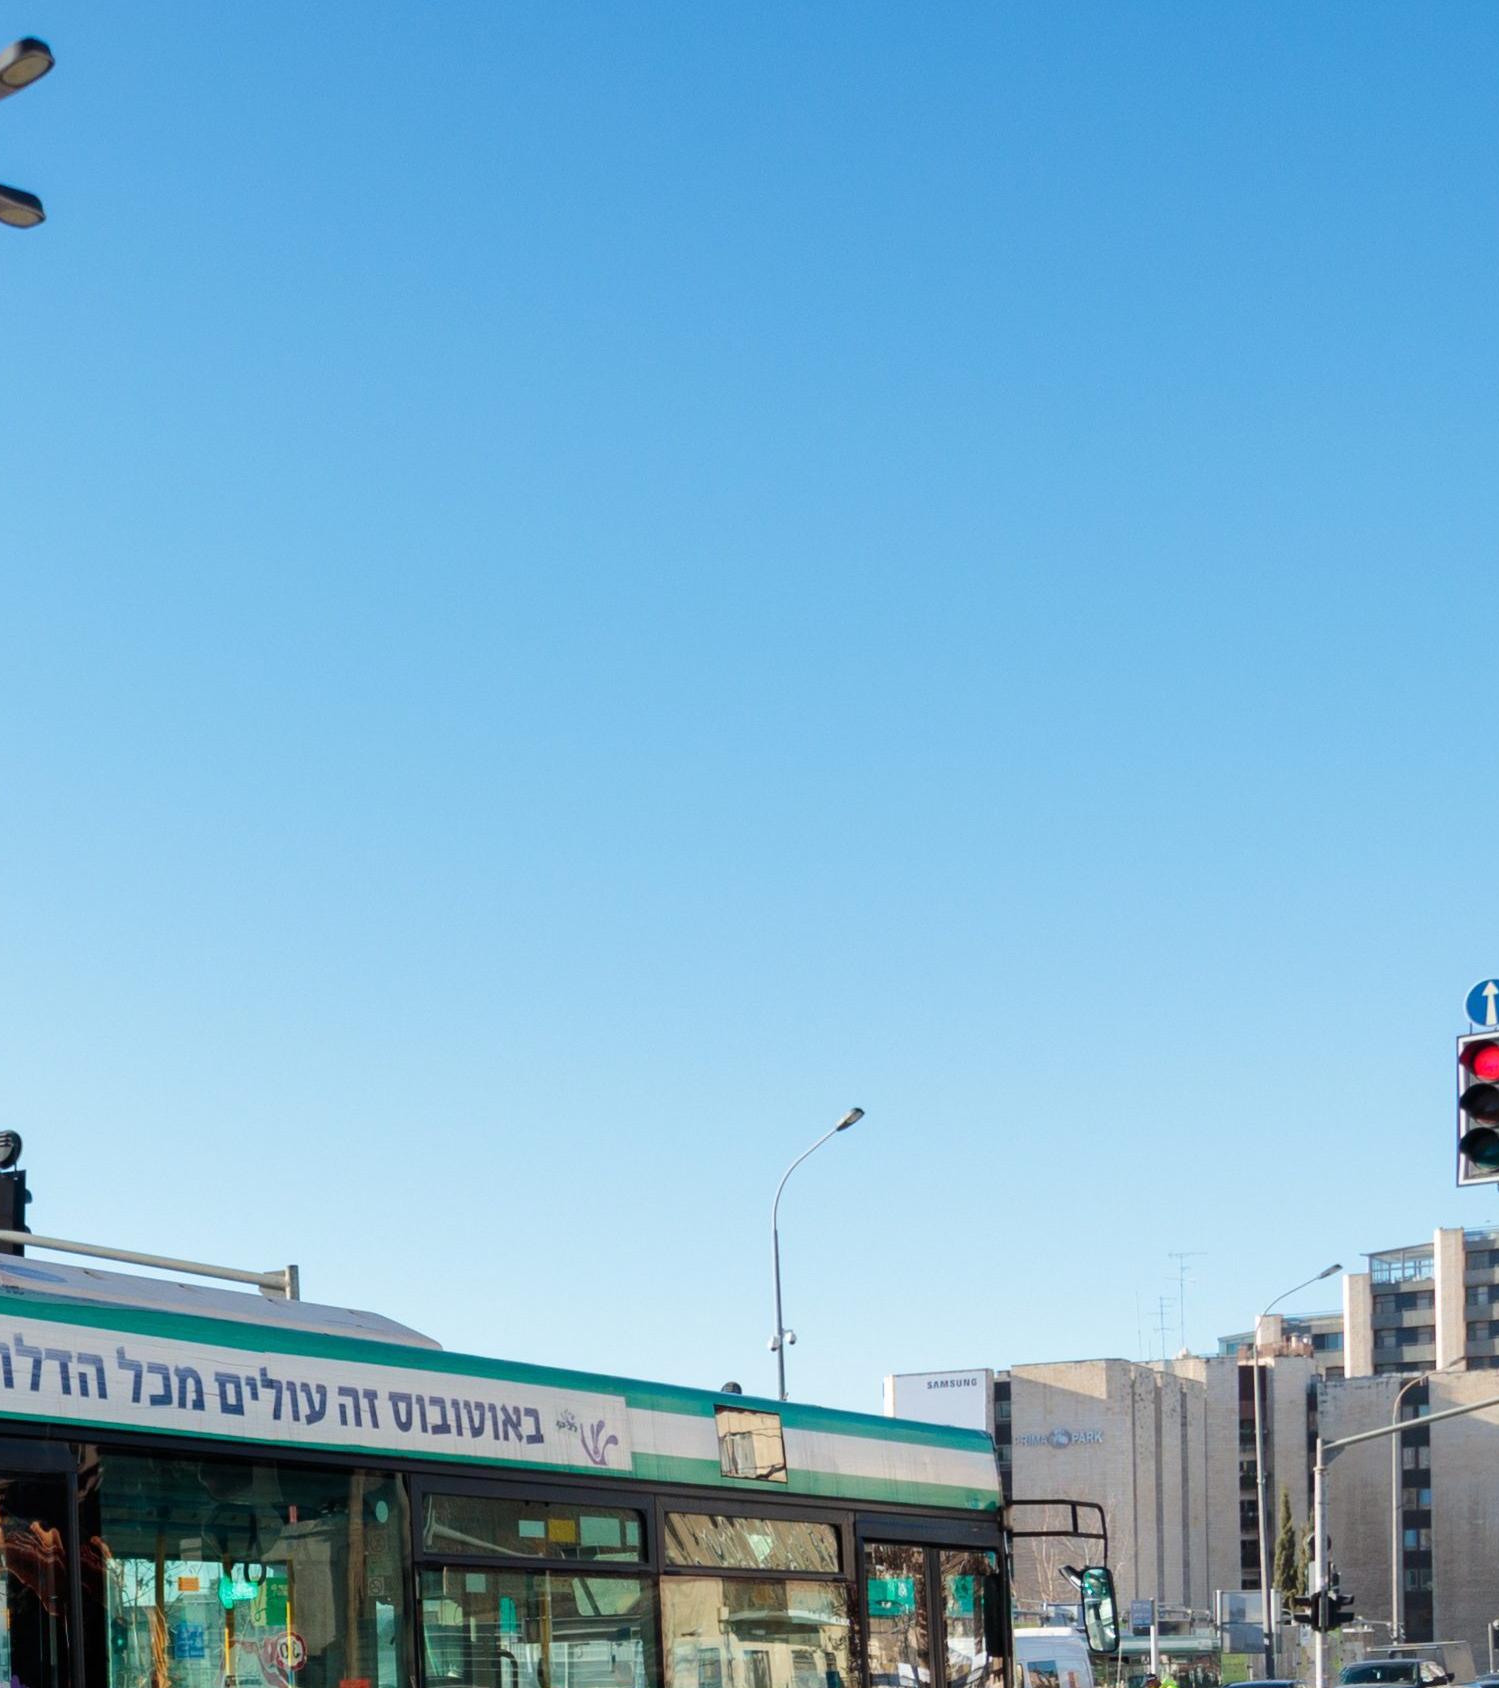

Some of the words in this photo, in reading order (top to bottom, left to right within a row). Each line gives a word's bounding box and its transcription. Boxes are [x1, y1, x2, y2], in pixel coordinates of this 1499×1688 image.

[116, 1346, 203, 1411] מכל
[215, 1367, 327, 1423] עולים
[927, 1378, 978, 1390] SAMSUNG
[339, 1388, 384, 1430] זה
[391, 1391, 545, 1445] באוטובוס
[1015, 1433, 1048, 1447] PRIMA
[1071, 1431, 1103, 1444] PARK
